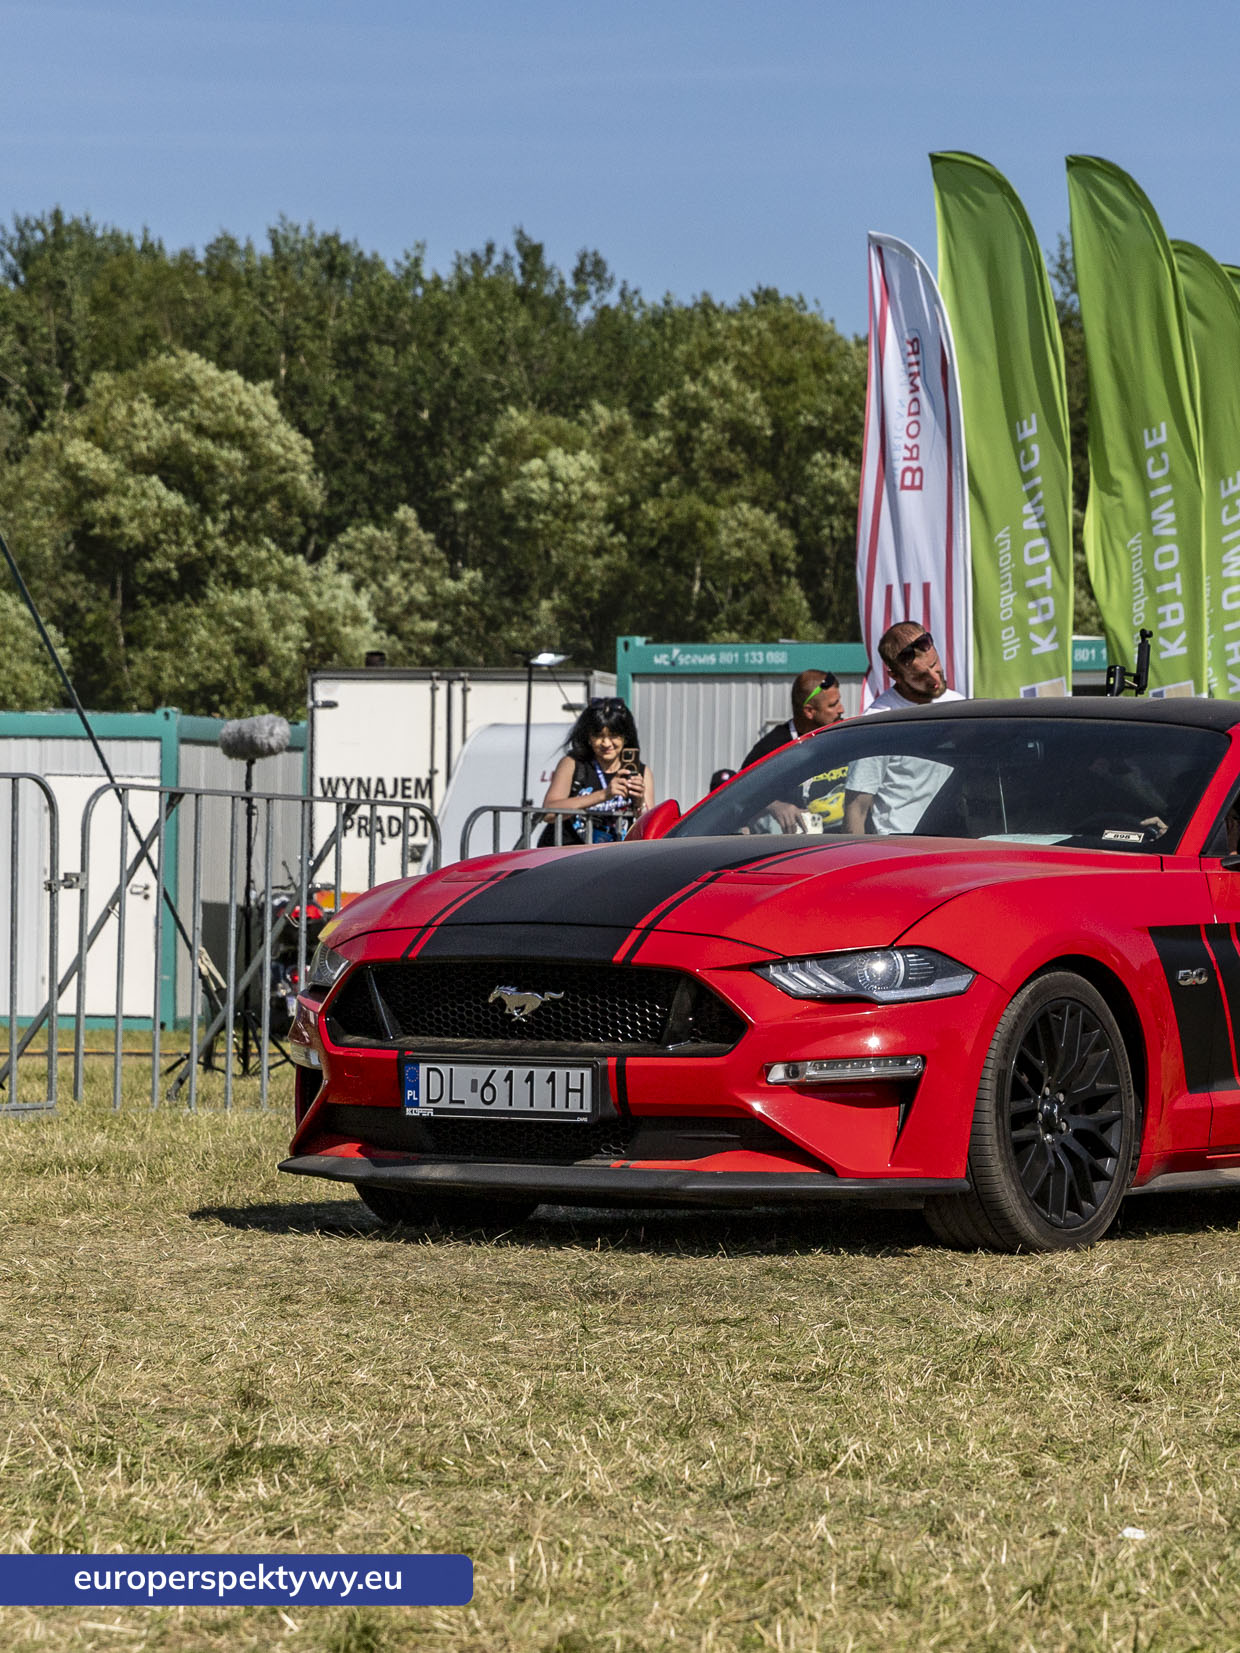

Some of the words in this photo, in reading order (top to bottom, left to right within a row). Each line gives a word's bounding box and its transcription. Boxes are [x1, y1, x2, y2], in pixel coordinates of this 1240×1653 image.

[320, 776, 432, 800] WYNAJEM
[407, 1089, 418, 1101] PL
[426, 1066, 466, 1105] DL
[480, 1069, 585, 1110] 6111H
